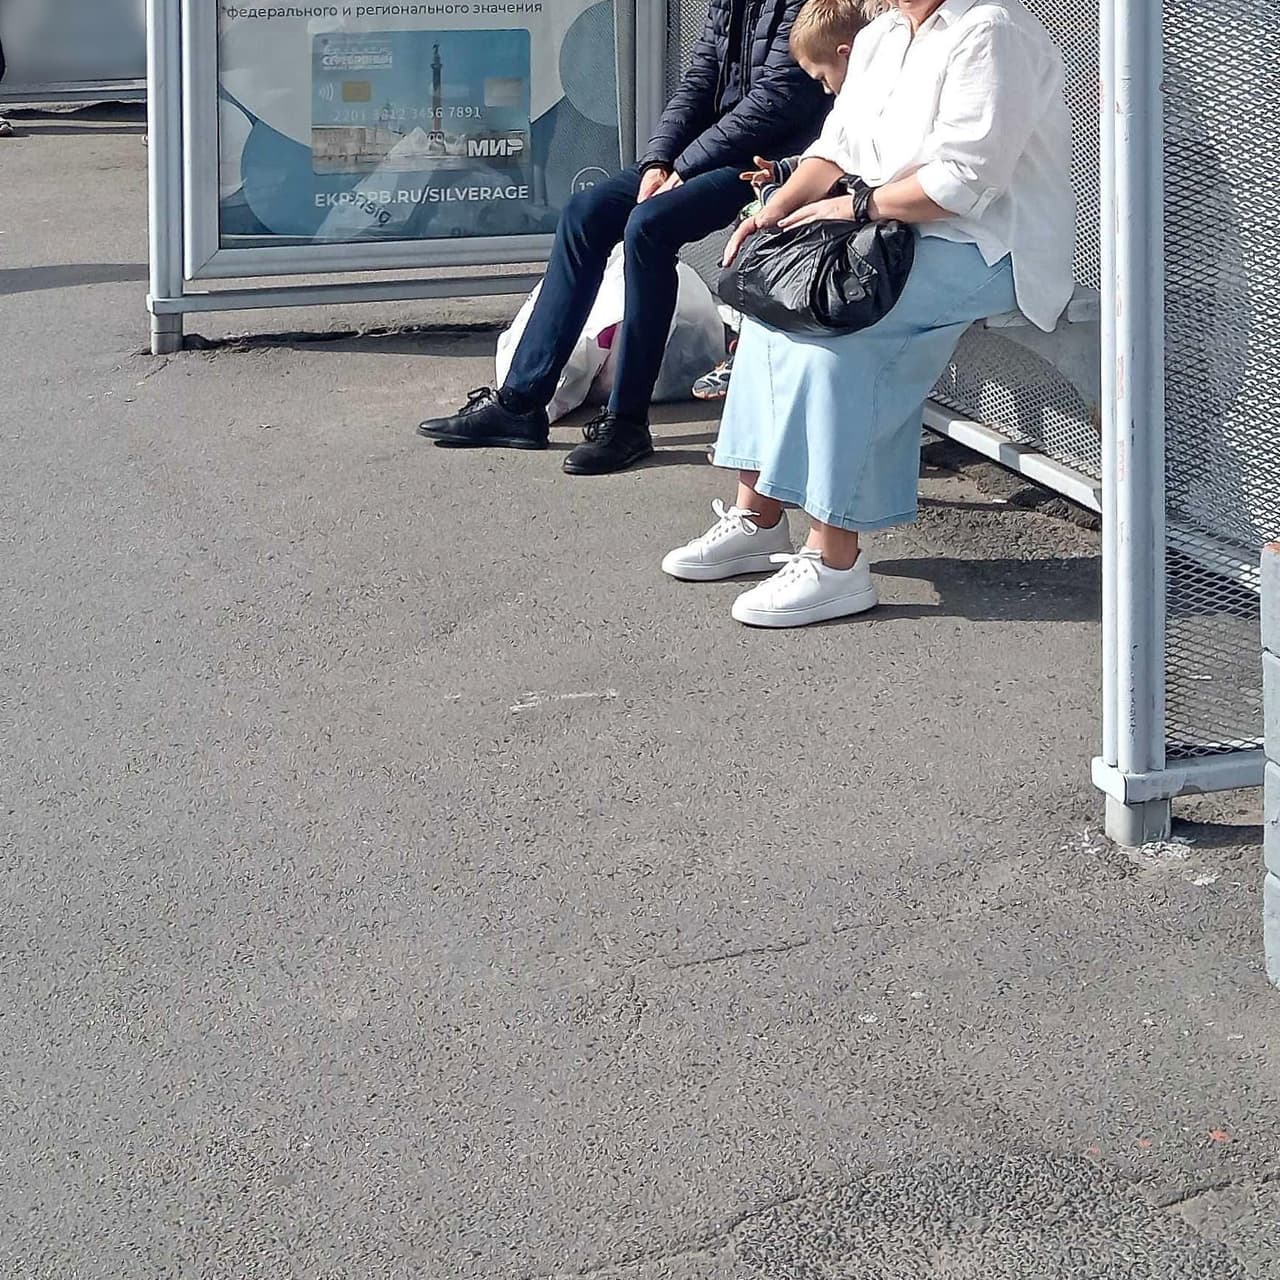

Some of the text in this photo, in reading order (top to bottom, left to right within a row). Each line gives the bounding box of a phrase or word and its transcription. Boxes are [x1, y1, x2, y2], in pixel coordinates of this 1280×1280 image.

[341, 6, 351, 16] и
[355, 4, 469, 18] регионального
[472, 1, 543, 15] значения
[448, 106, 482, 119] 7891
[467, 138, 524, 158] МИР
